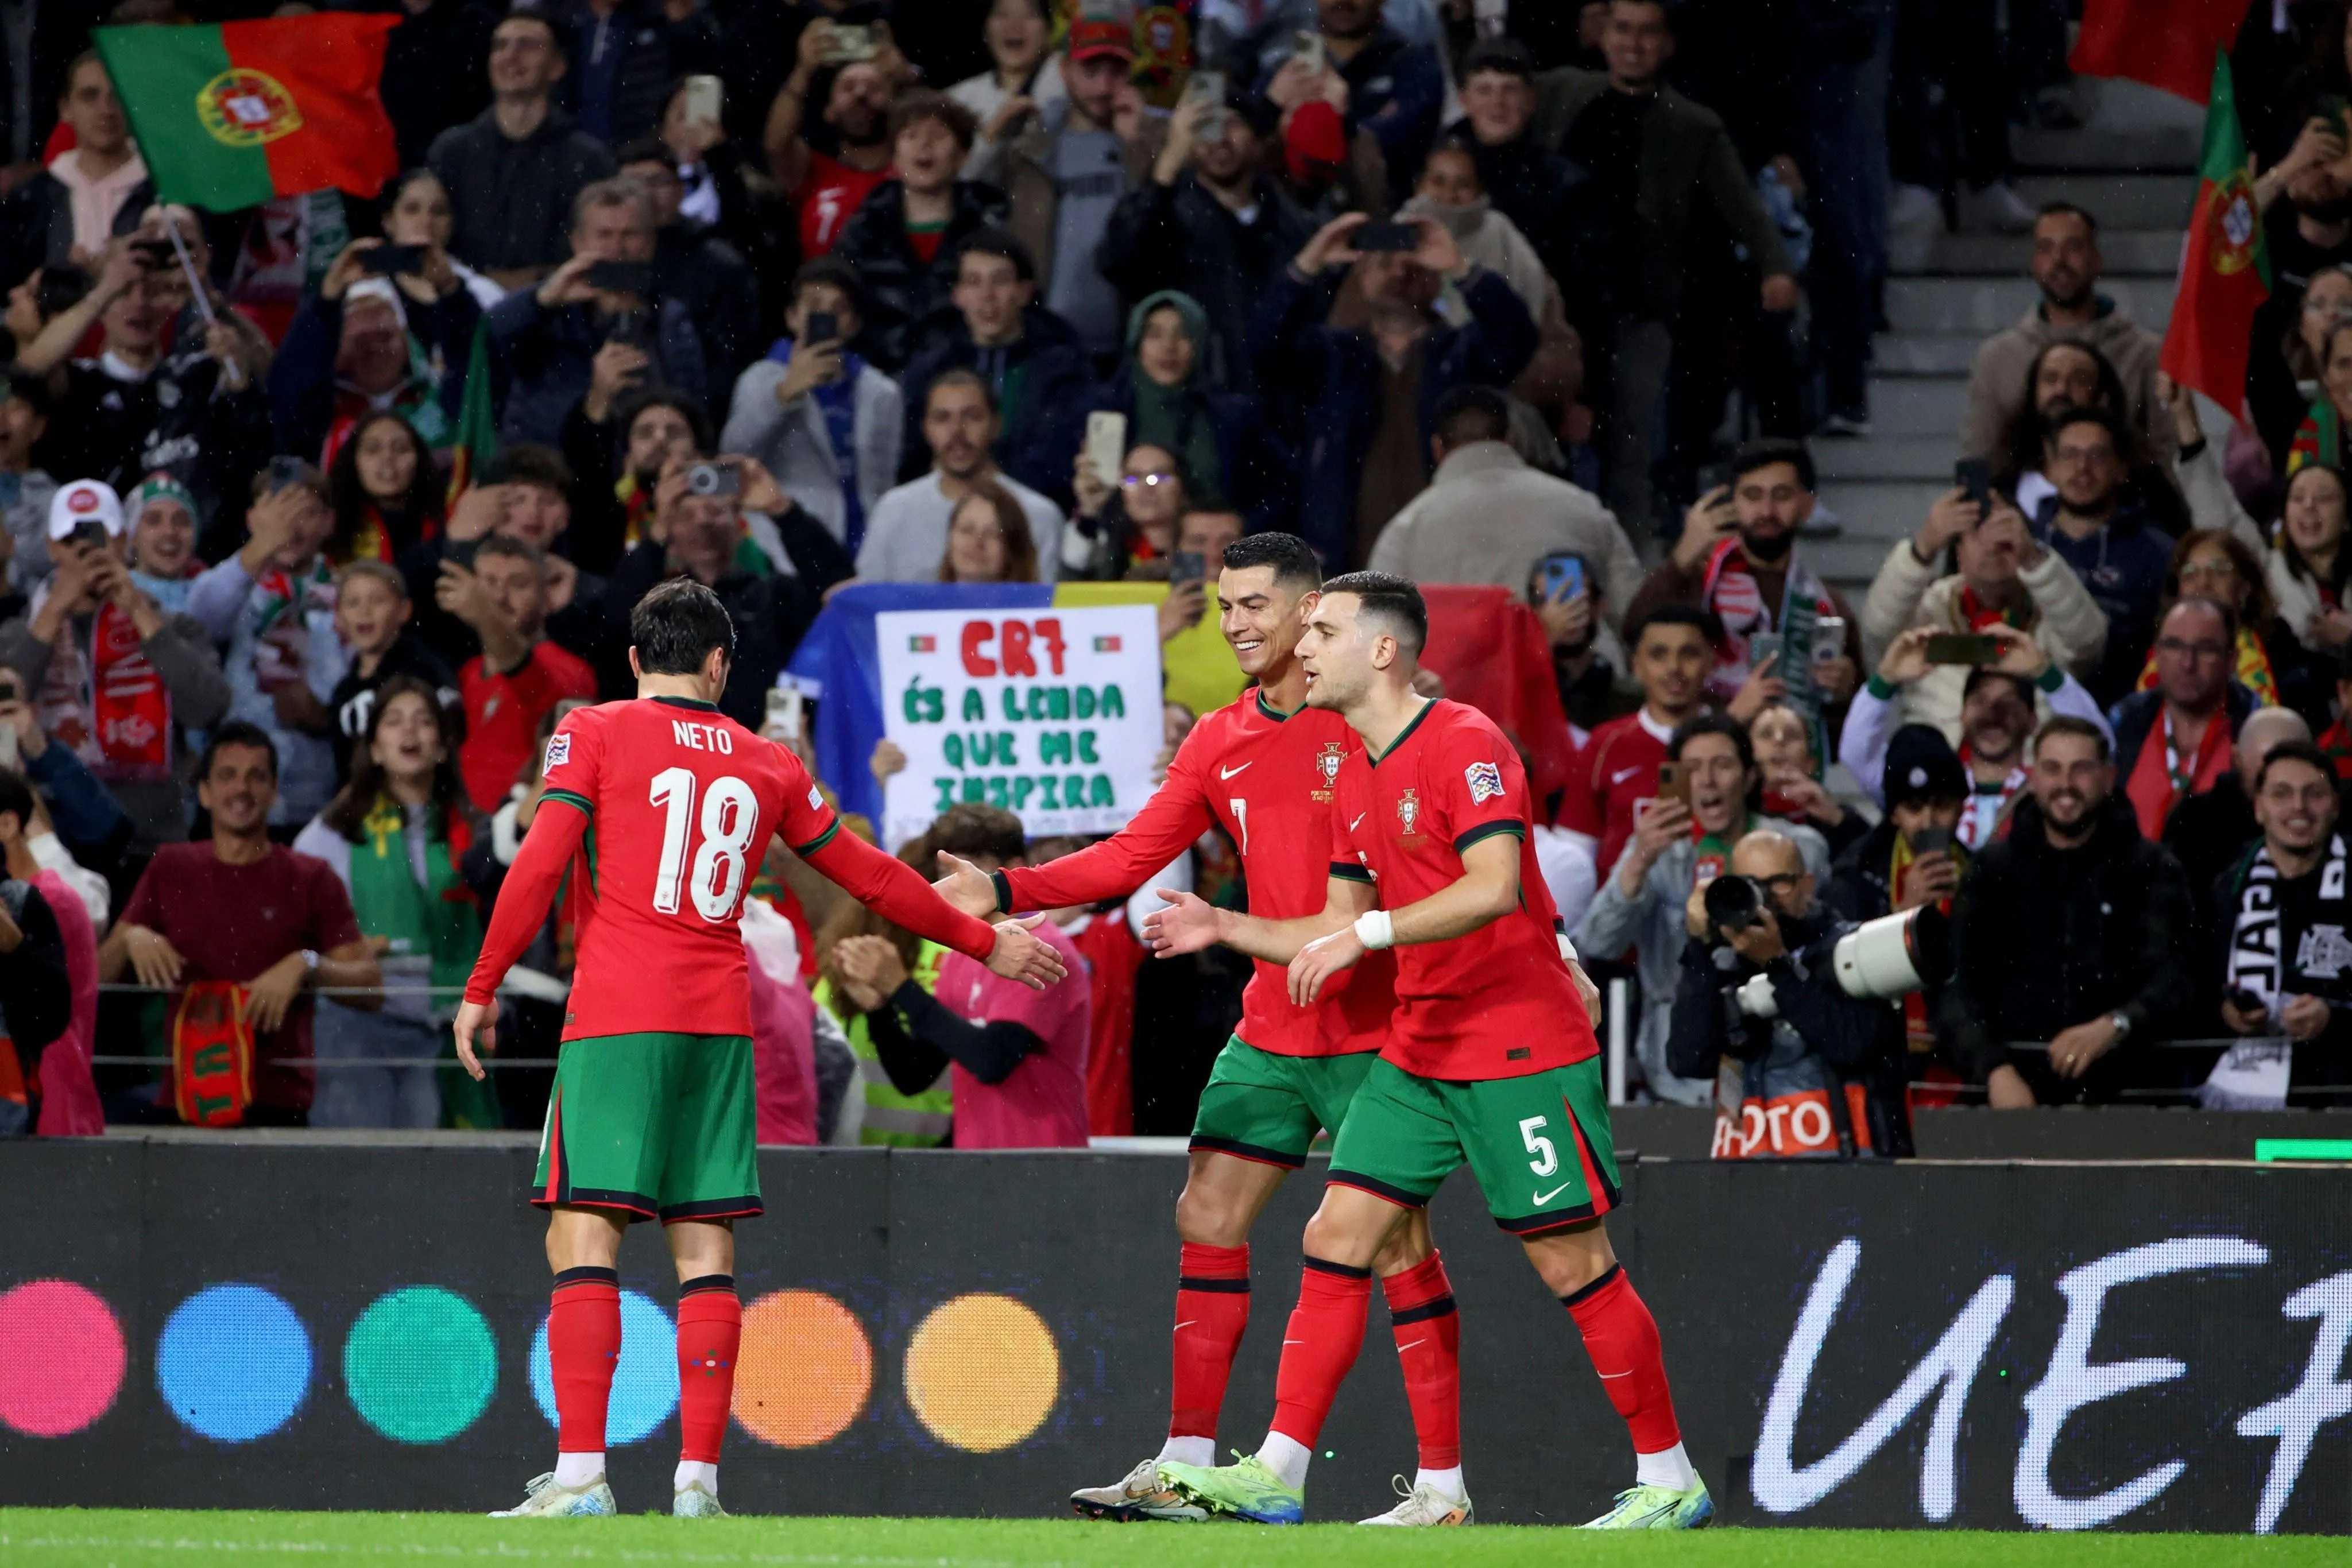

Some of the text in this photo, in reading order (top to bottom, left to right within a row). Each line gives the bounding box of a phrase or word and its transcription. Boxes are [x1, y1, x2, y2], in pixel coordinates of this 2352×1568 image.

[961, 617, 1067, 677] CR7
[903, 674, 1125, 723] ÉS A LENDA
[671, 719, 733, 755] NETO
[943, 730, 1100, 771] QUE ME
[934, 773, 1115, 812] INSPIRA
[649, 766, 759, 924] 18
[1229, 798, 1248, 856] 7
[1518, 1115, 1558, 1177] 5
